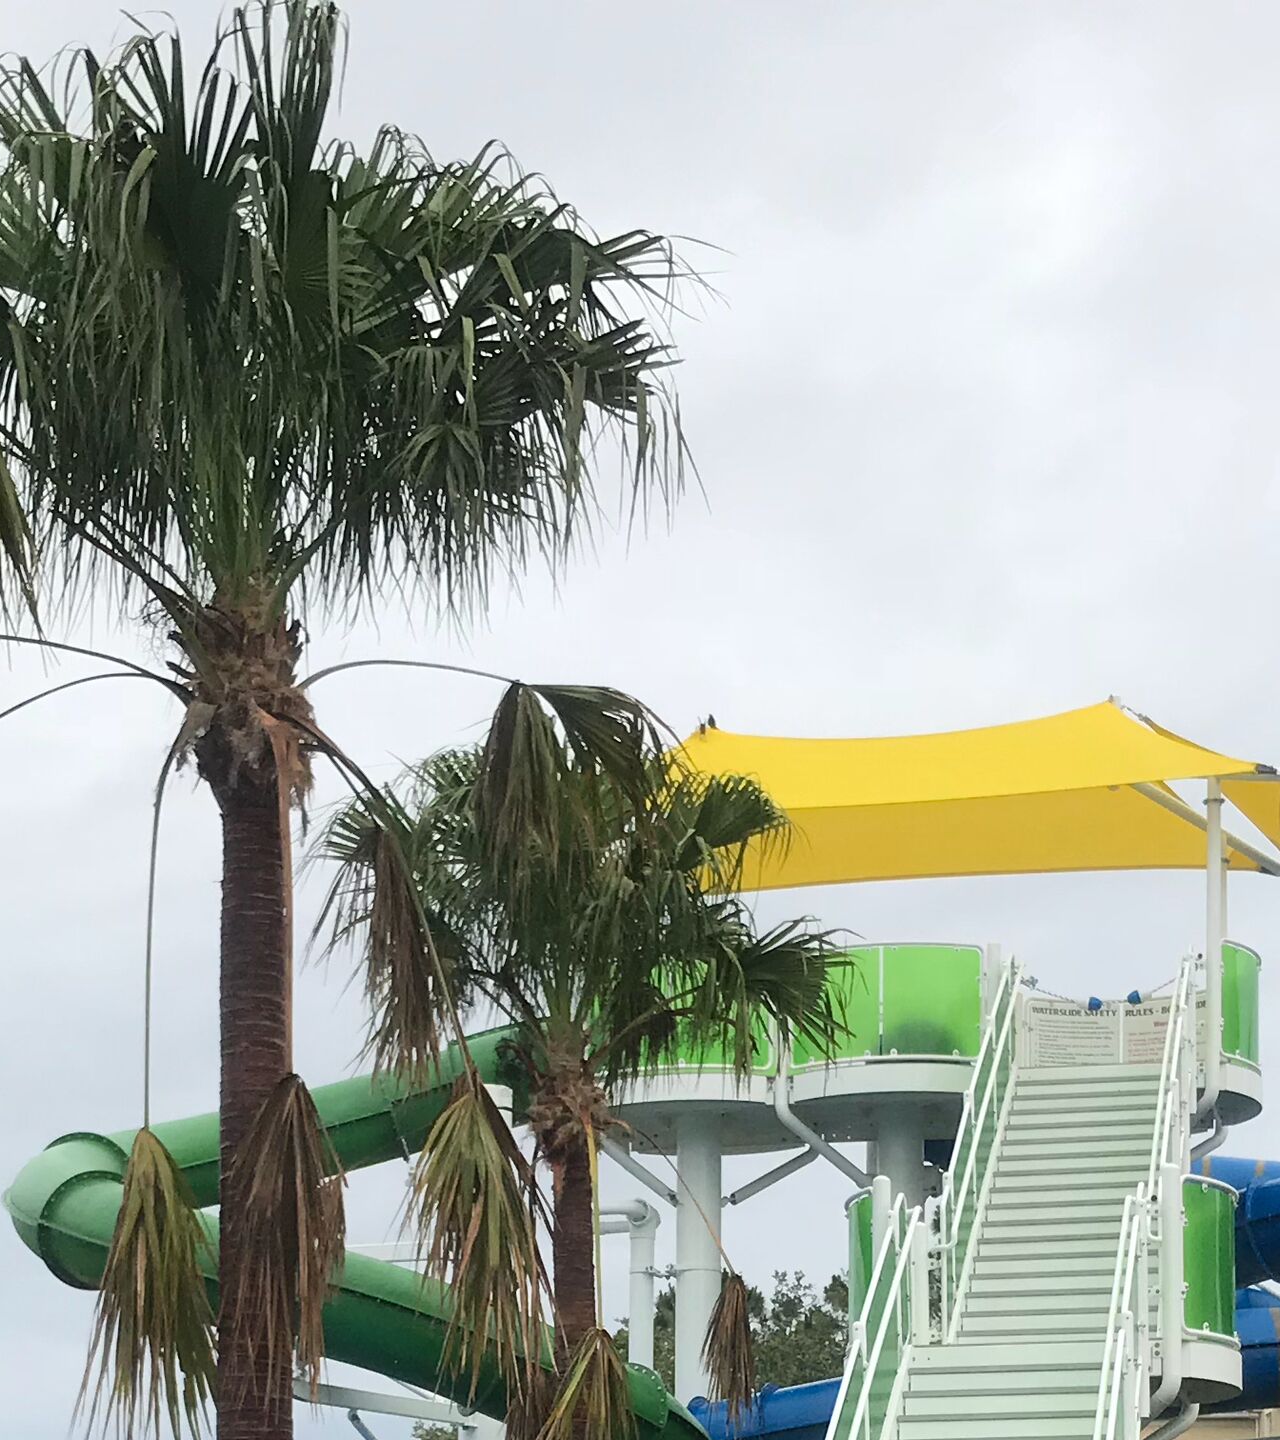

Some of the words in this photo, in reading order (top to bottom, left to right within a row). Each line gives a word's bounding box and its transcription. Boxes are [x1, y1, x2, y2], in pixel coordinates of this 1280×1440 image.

[1031, 1006, 1082, 1017] WATERSLIDE
[1084, 1009, 1118, 1017] SAFETY
[1125, 1007, 1154, 1017] RULES
